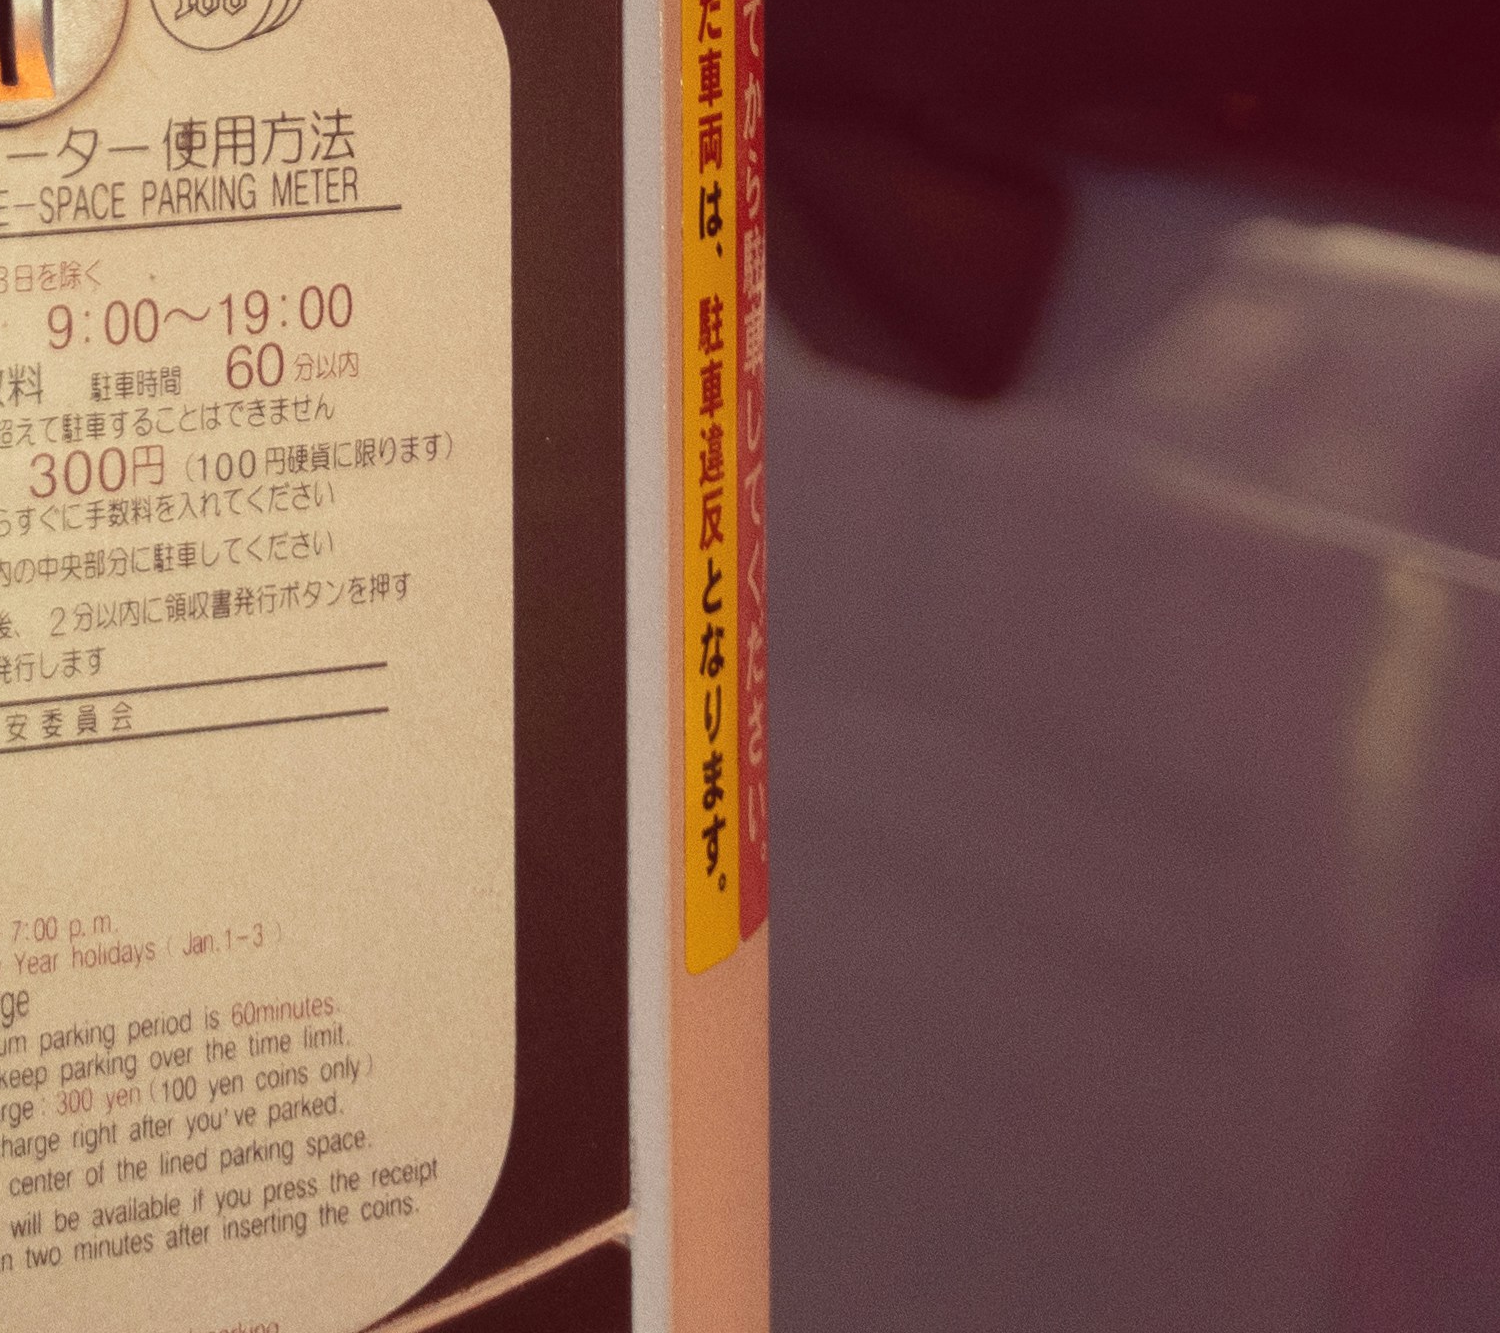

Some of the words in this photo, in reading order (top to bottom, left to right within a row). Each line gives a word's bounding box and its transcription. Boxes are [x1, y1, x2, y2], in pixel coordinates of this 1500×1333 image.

[142, 173, 257, 216] PARKING
[272, 158, 358, 207] METER
[90, 366, 181, 403] 駐車時間
[12, 916, 58, 943] 7:00
[14, 952, 58, 975] Year
[72, 940, 156, 969] holidays
[40, 1024, 116, 1057] parking
[128, 1009, 192, 1046] period
[204, 1010, 220, 1030] is
[60, 1049, 137, 1087] parking
[149, 1047, 193, 1071] over
[205, 1038, 236, 1063] the
[248, 1034, 291, 1057] time
[303, 1023, 350, 1049] limit.
[57, 1088, 93, 1116] 300
[105, 1089, 141, 1115] yen
[209, 1075, 243, 1103] yen
[255, 1066, 309, 1092] coins
[72, 1122, 117, 1155] right
[129, 1115, 173, 1142] after
[267, 1091, 344, 1128] parked.
[9, 1169, 73, 1197] center
[85, 1160, 104, 1188] of
[116, 1158, 148, 1182] the
[160, 1147, 208, 1176] lined
[220, 1140, 294, 1173] parking
[306, 1130, 372, 1160] space.
[10, 1212, 42, 1239] will
[54, 1210, 80, 1234] be
[92, 1194, 181, 1229] available
[215, 1189, 251, 1216] you
[263, 1178, 318, 1210] press
[330, 1170, 360, 1194] the
[372, 1158, 438, 1188] receipt
[25, 1246, 62, 1269] two
[74, 1232, 154, 1261] minutes
[166, 1223, 210, 1250] after
[223, 1211, 308, 1240] inserting
[318, 1203, 349, 1227] the
[360, 1196, 419, 1222] coins.
